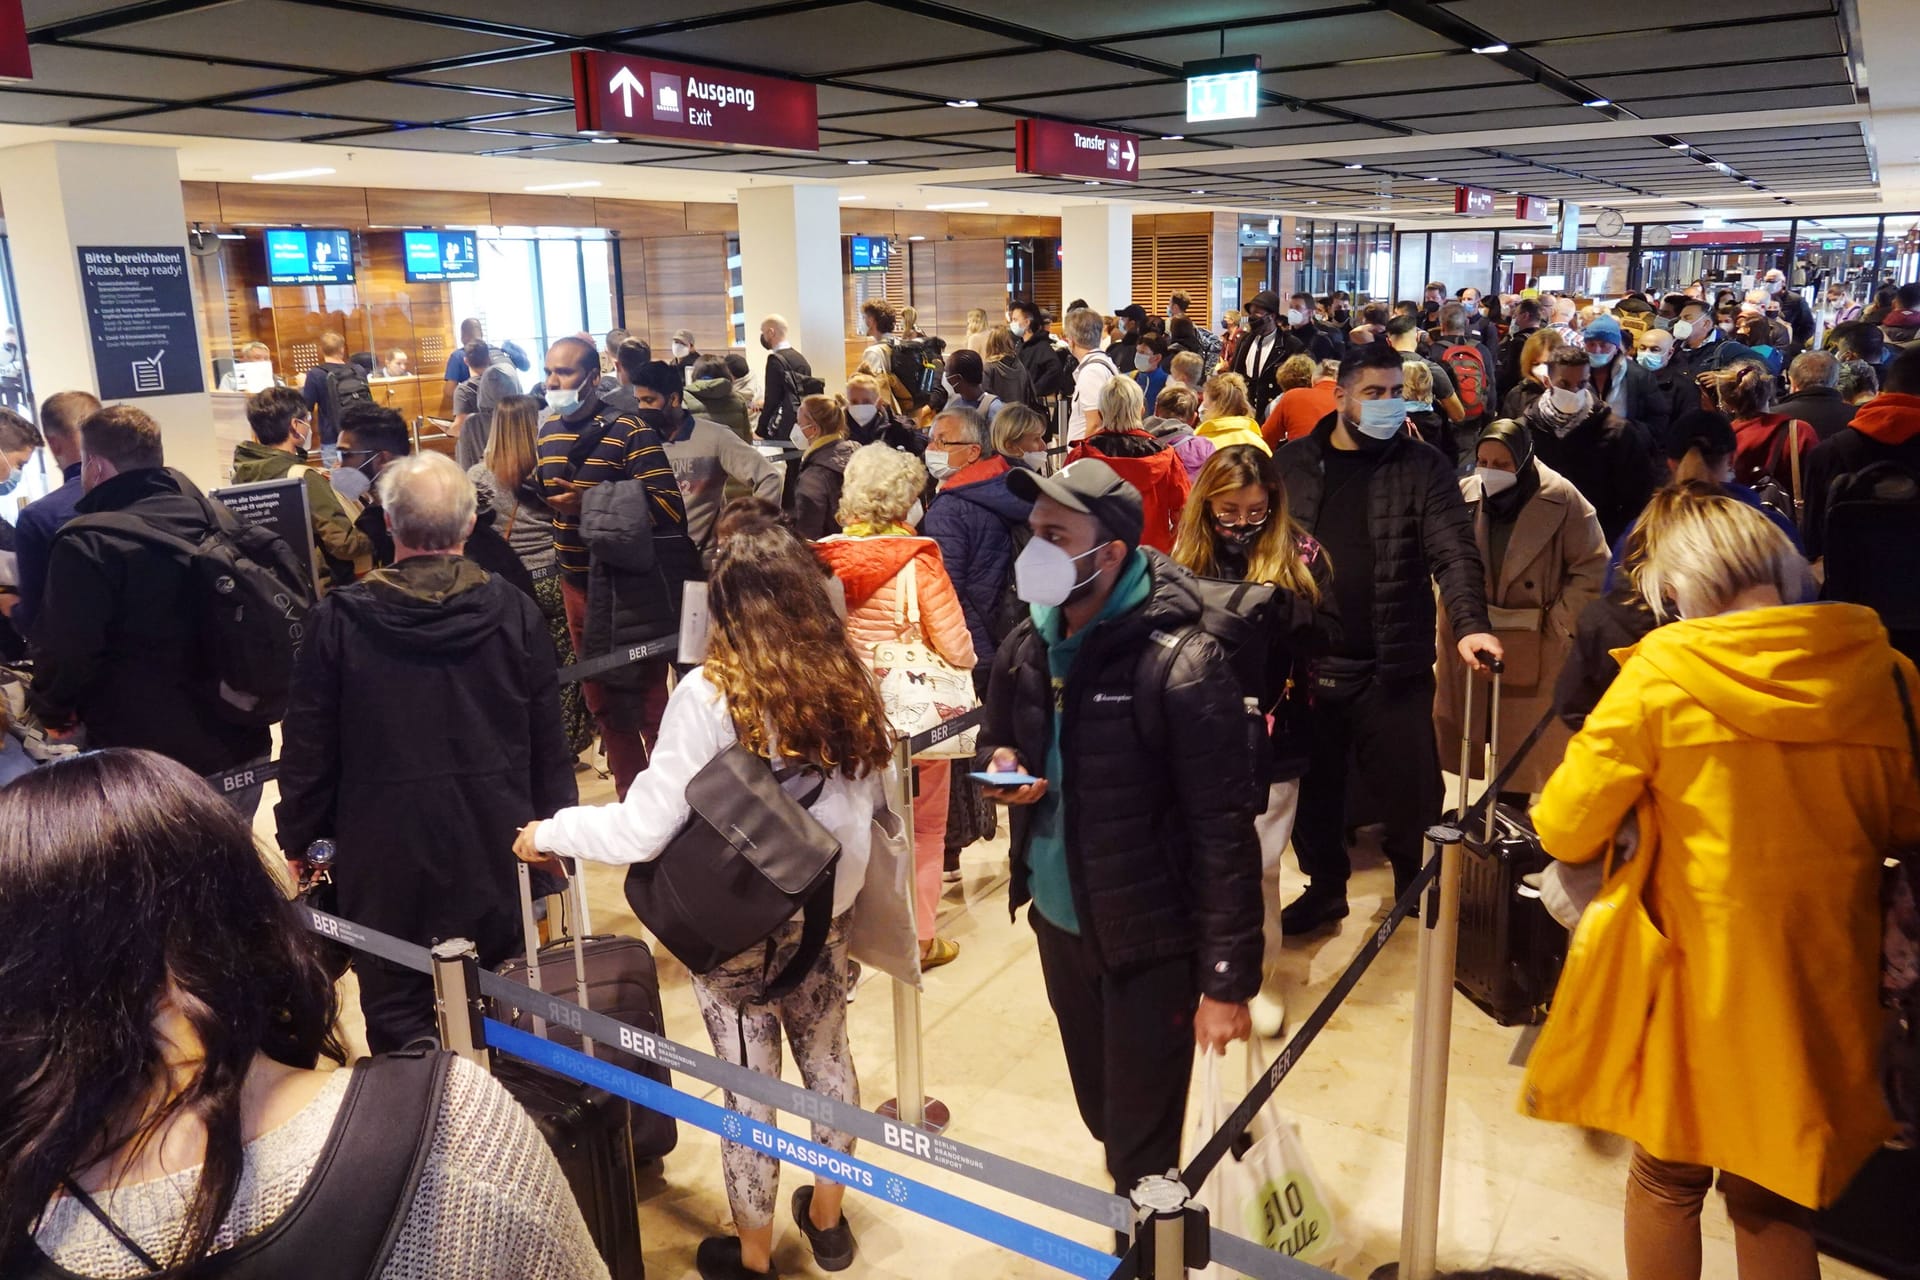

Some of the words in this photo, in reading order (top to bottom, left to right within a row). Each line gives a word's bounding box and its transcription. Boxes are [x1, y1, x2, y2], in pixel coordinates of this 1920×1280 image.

[687, 77, 755, 111] Ausgang
[688, 107, 713, 127] Exit
[1073, 132, 1106, 151] Transfer
[85, 252, 112, 264] Bitte
[114, 252, 181, 264] bereithalten!
[87, 264, 123, 277] Please,
[125, 264, 150, 277] keep
[152, 264, 182, 277] ready!
[249, 492, 280, 502] Dokumente
[531, 567, 548, 580] BER
[629, 645, 648, 661] BER
[931, 724, 948, 744] BER
[223, 770, 256, 792] BER
[312, 912, 340, 938] BER
[1377, 917, 1392, 949] BER
[620, 1026, 657, 1059] BER
[1270, 1049, 1291, 1089] BER
[884, 1122, 931, 1159] BER
[933, 1138, 958, 1152] BERLIN
[752, 1128, 773, 1148] EU
[777, 1140, 873, 1187] PASSPORTS
[934, 1146, 984, 1169] BRANDENBURG
[934, 1154, 963, 1170] AIRPORT
